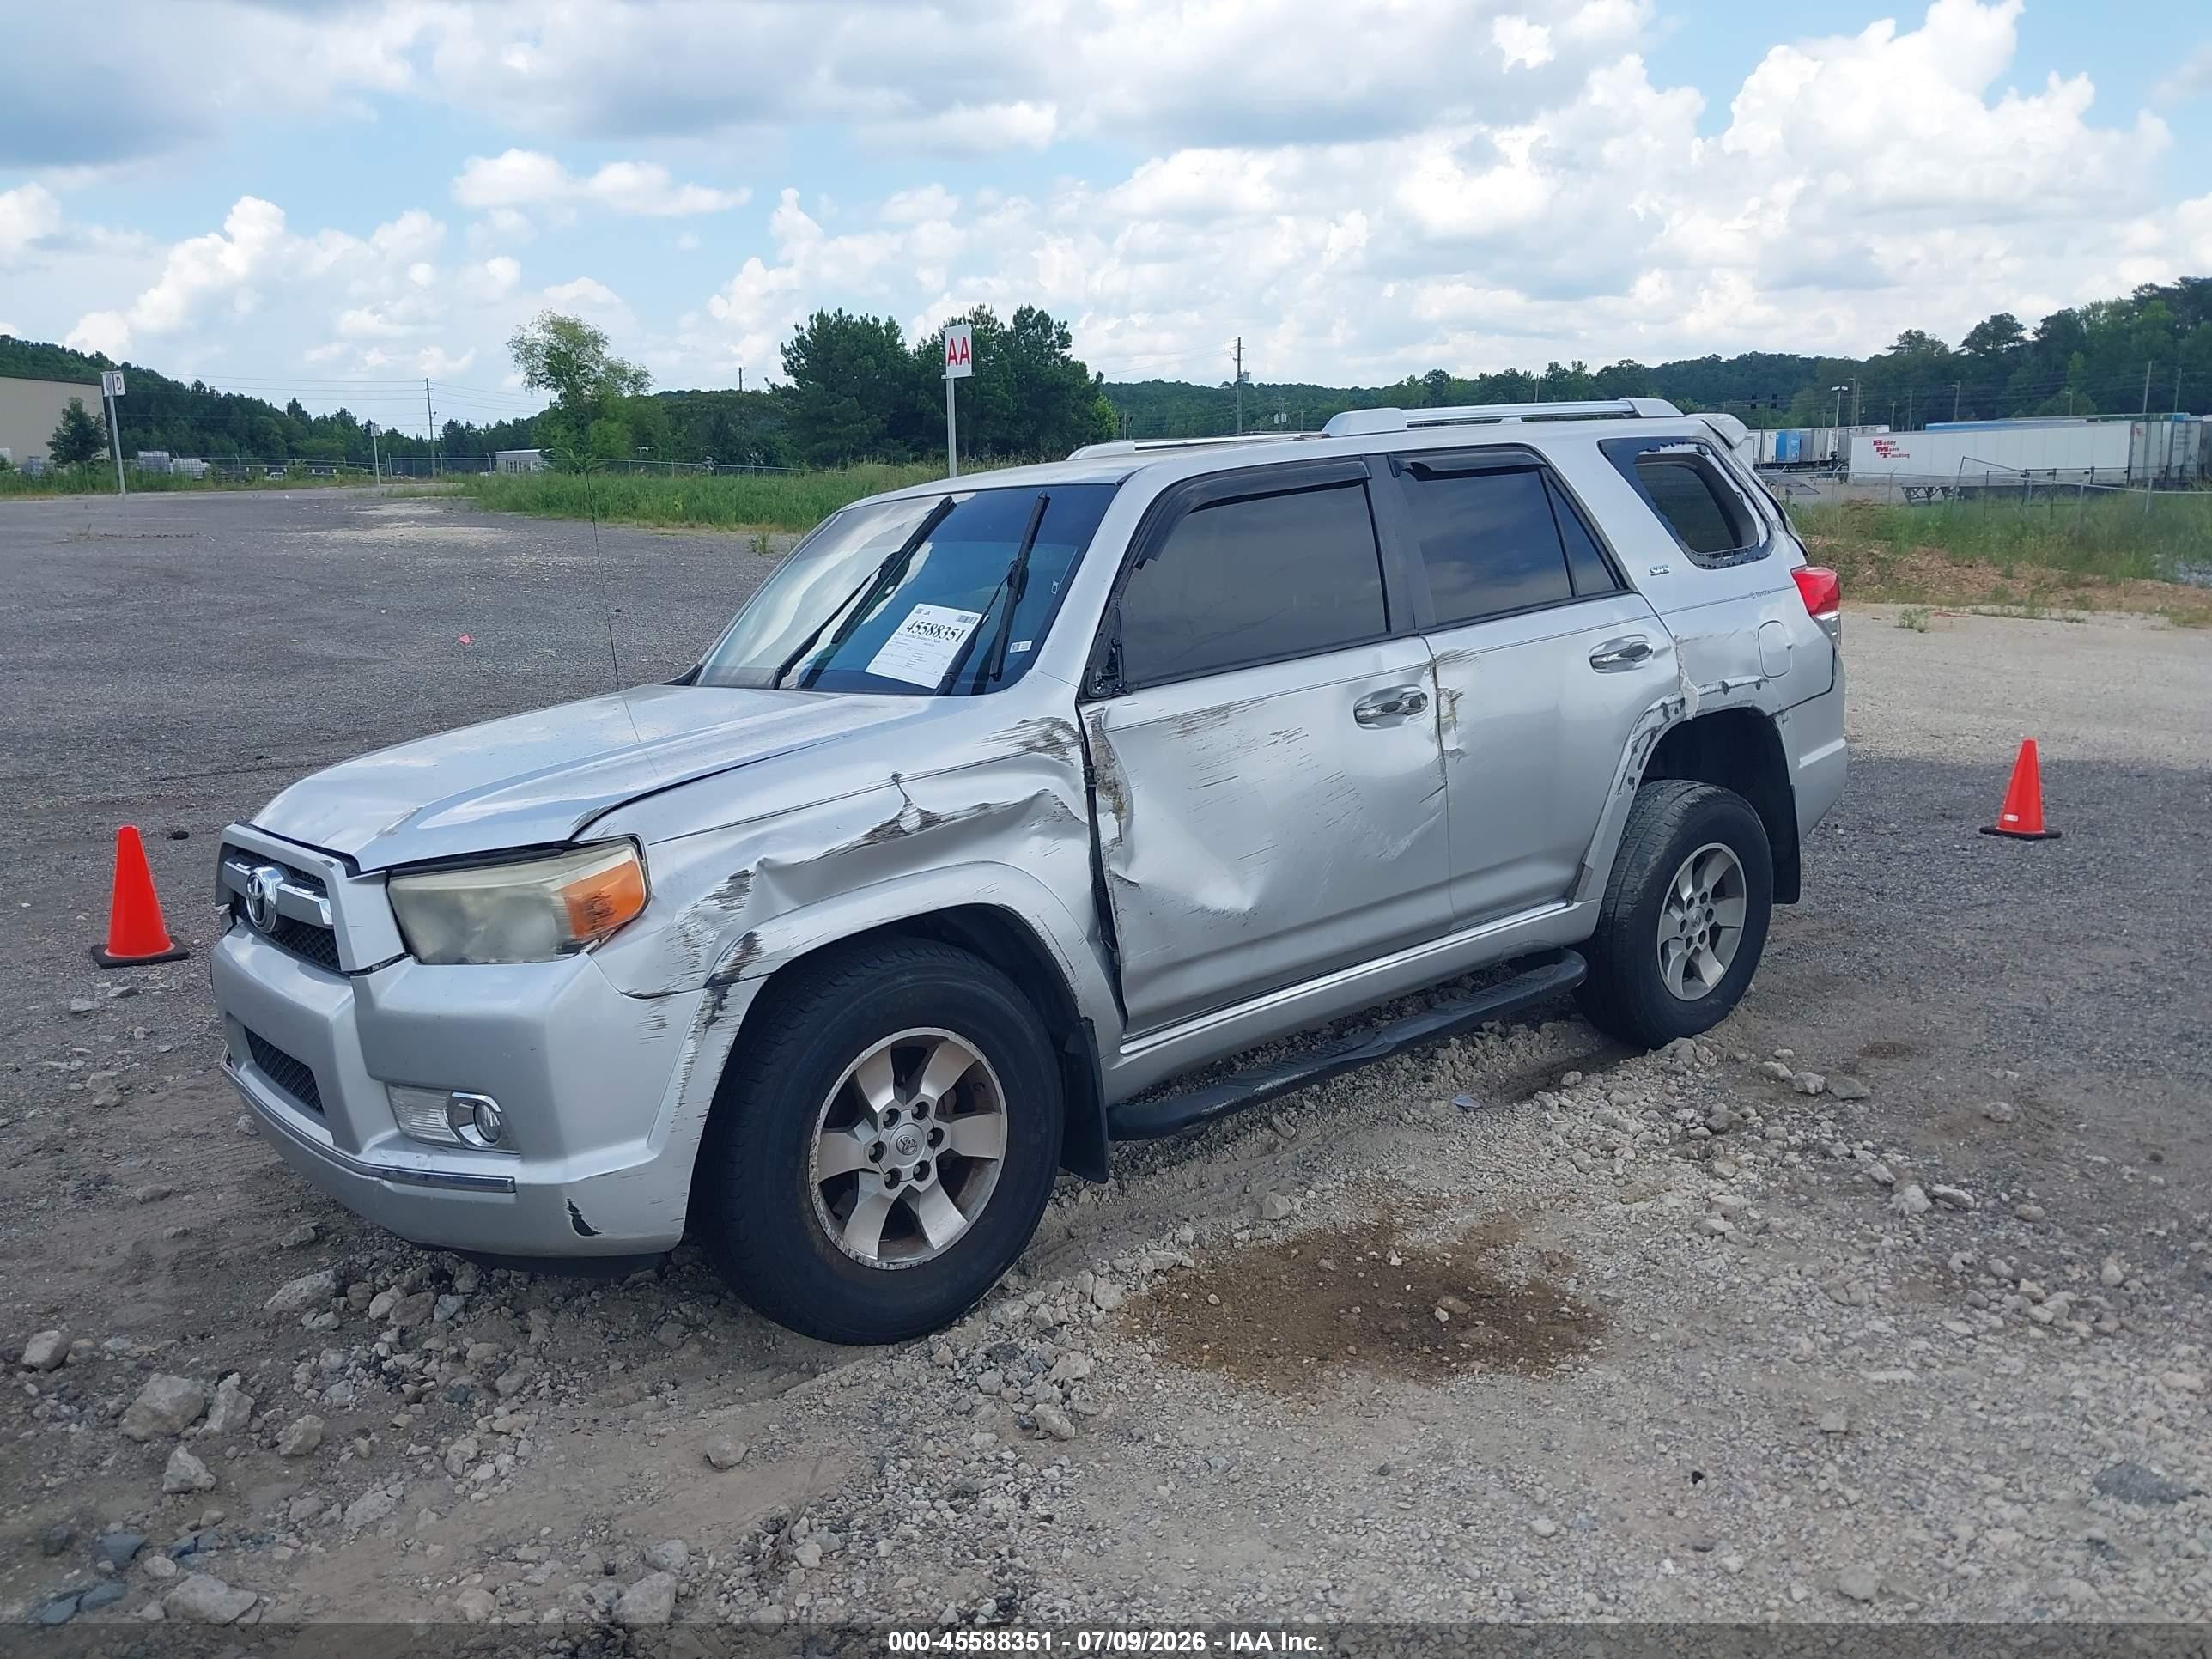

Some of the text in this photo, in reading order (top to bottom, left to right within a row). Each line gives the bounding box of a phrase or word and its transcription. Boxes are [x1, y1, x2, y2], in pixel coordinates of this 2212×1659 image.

[947, 337, 970, 367] AA
[116, 376, 122, 390] D
[906, 620, 966, 642] 45588351
